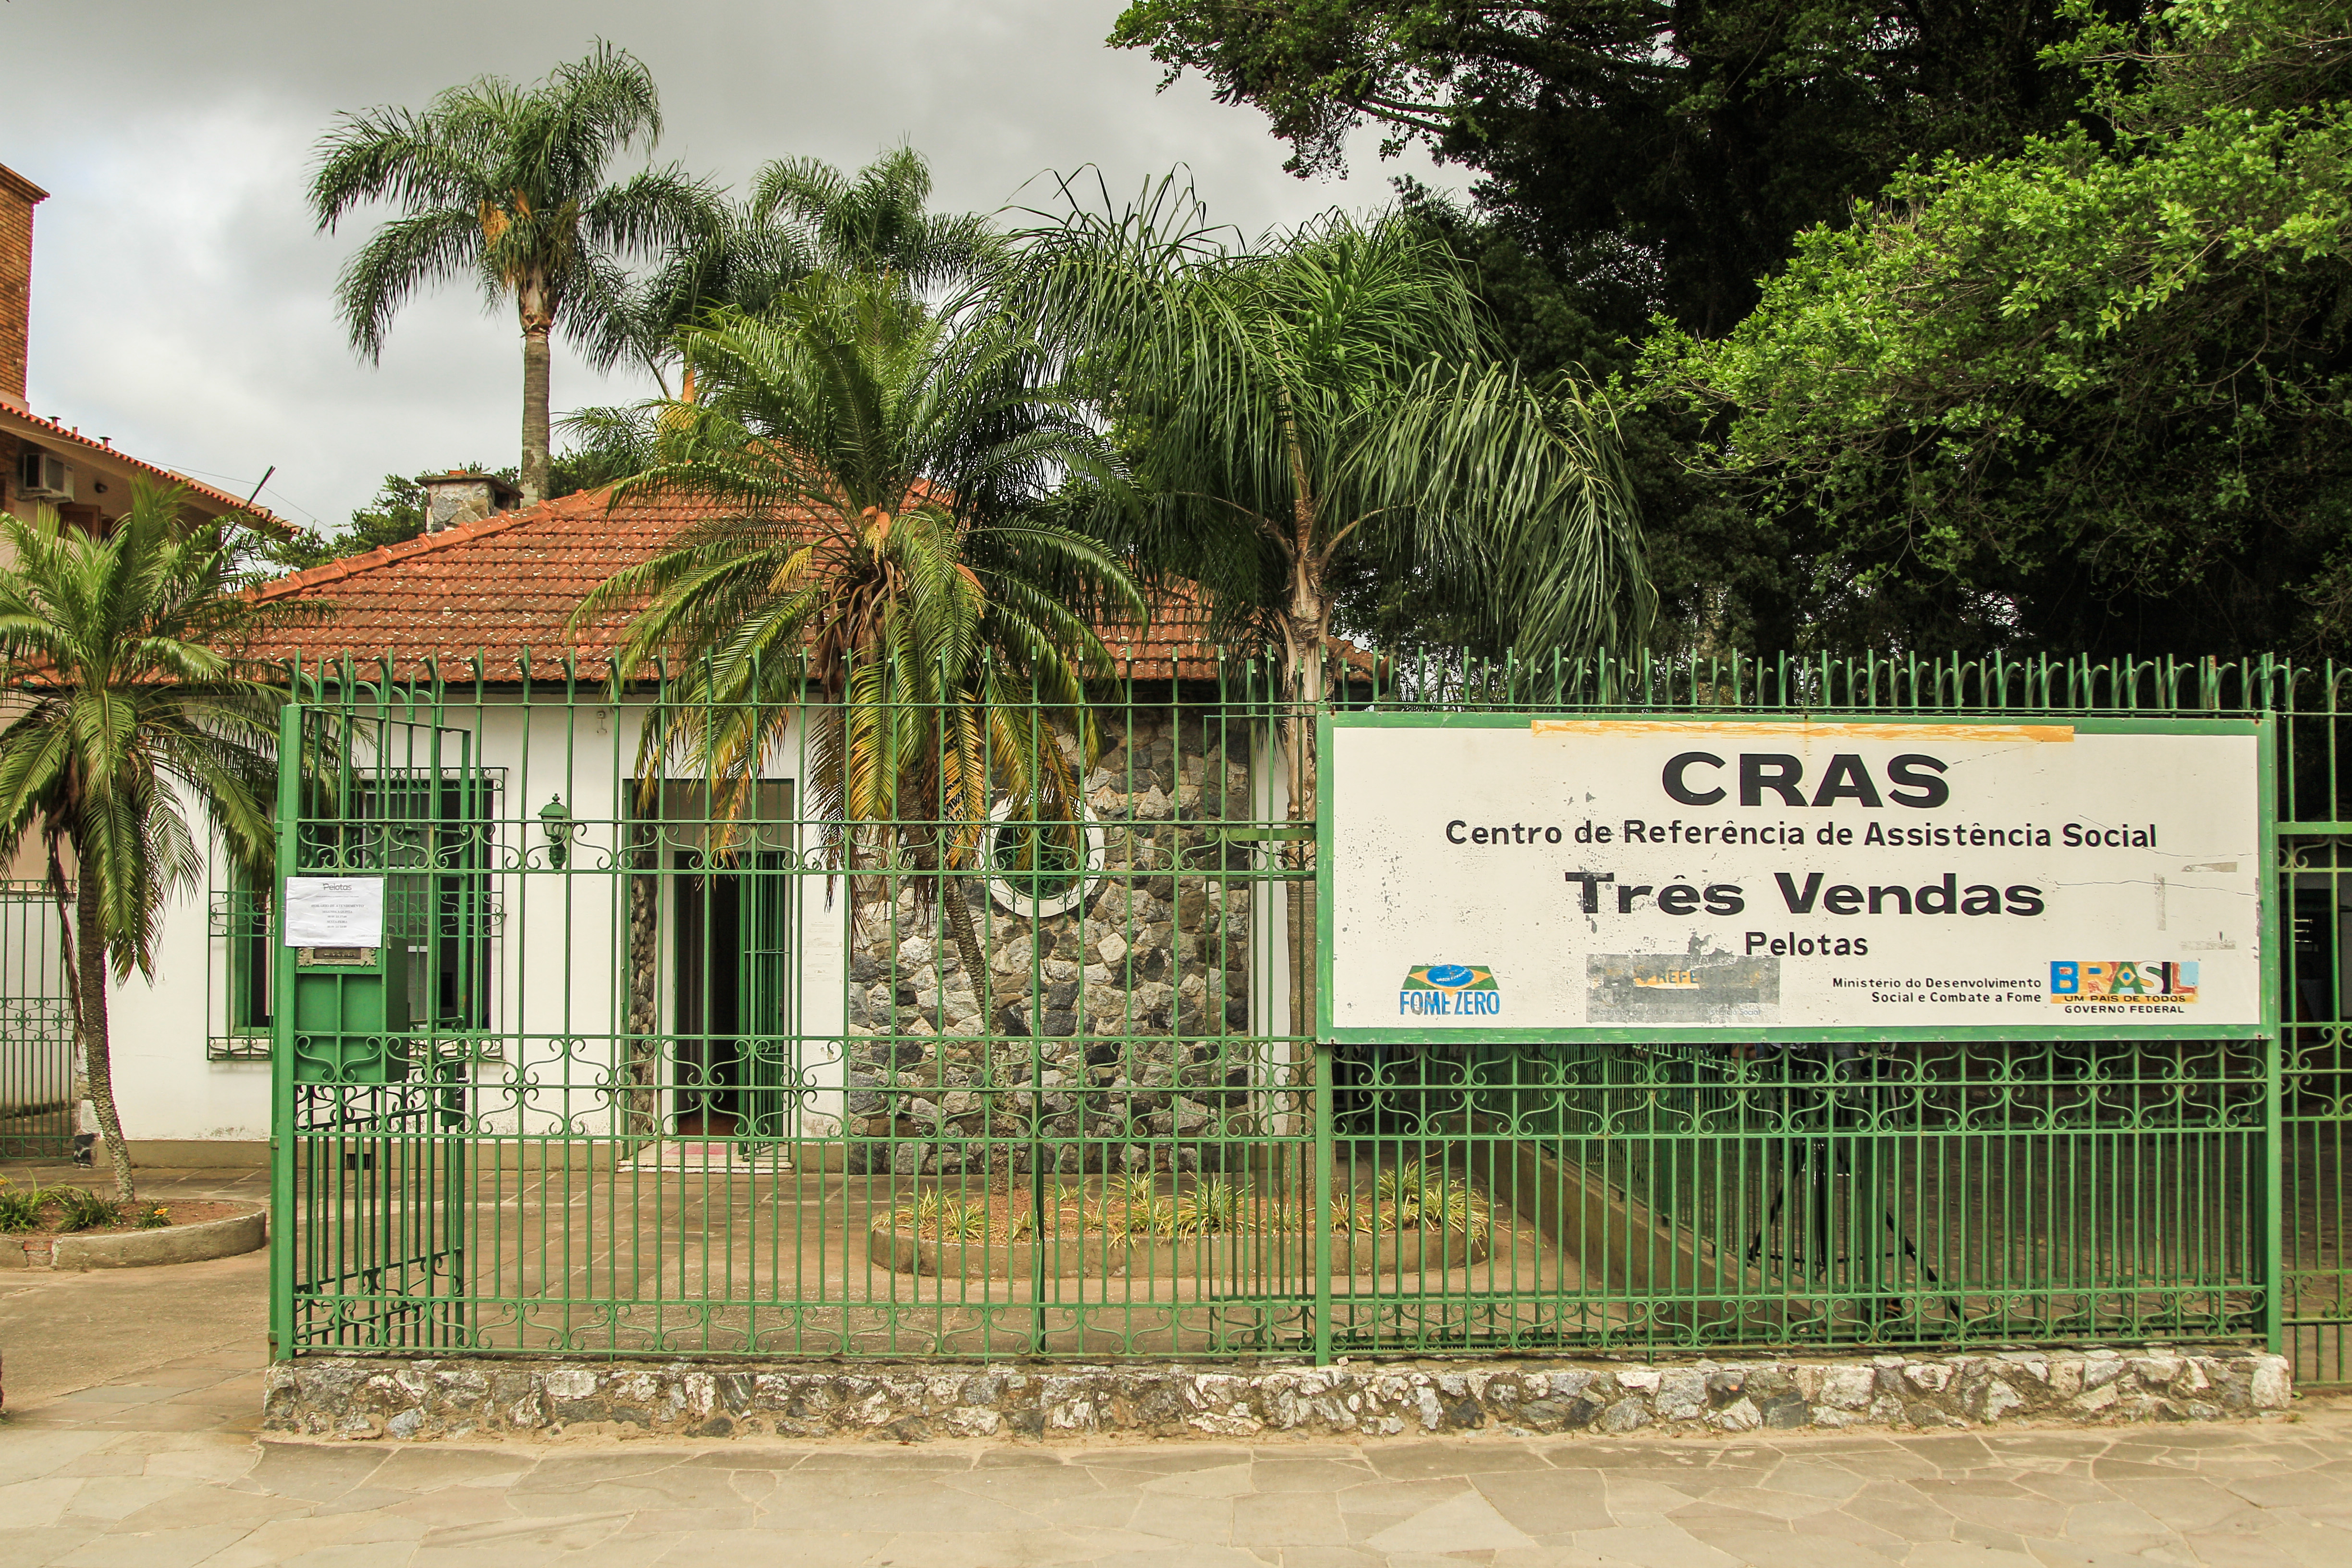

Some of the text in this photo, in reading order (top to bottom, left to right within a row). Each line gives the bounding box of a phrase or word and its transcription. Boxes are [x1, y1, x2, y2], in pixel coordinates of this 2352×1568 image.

[1662, 751, 1949, 808] CRAS
[1446, 820, 2156, 847] Centro de Referência de Assistência Social
[1565, 872, 2044, 916] Três Vendas
[1746, 932, 1868, 956] Pelotas
[1833, 978, 2041, 988] Ministério do Desenvolvimento
[2051, 960, 2197, 995] BRASIL
[1399, 991, 1500, 1015] FOME ZERO
[1872, 992, 1913, 1003] Social
[1930, 992, 1990, 1002] Combate
[2007, 992, 2041, 1002] Fome
[2065, 1005, 2125, 1014] GOVERNO
